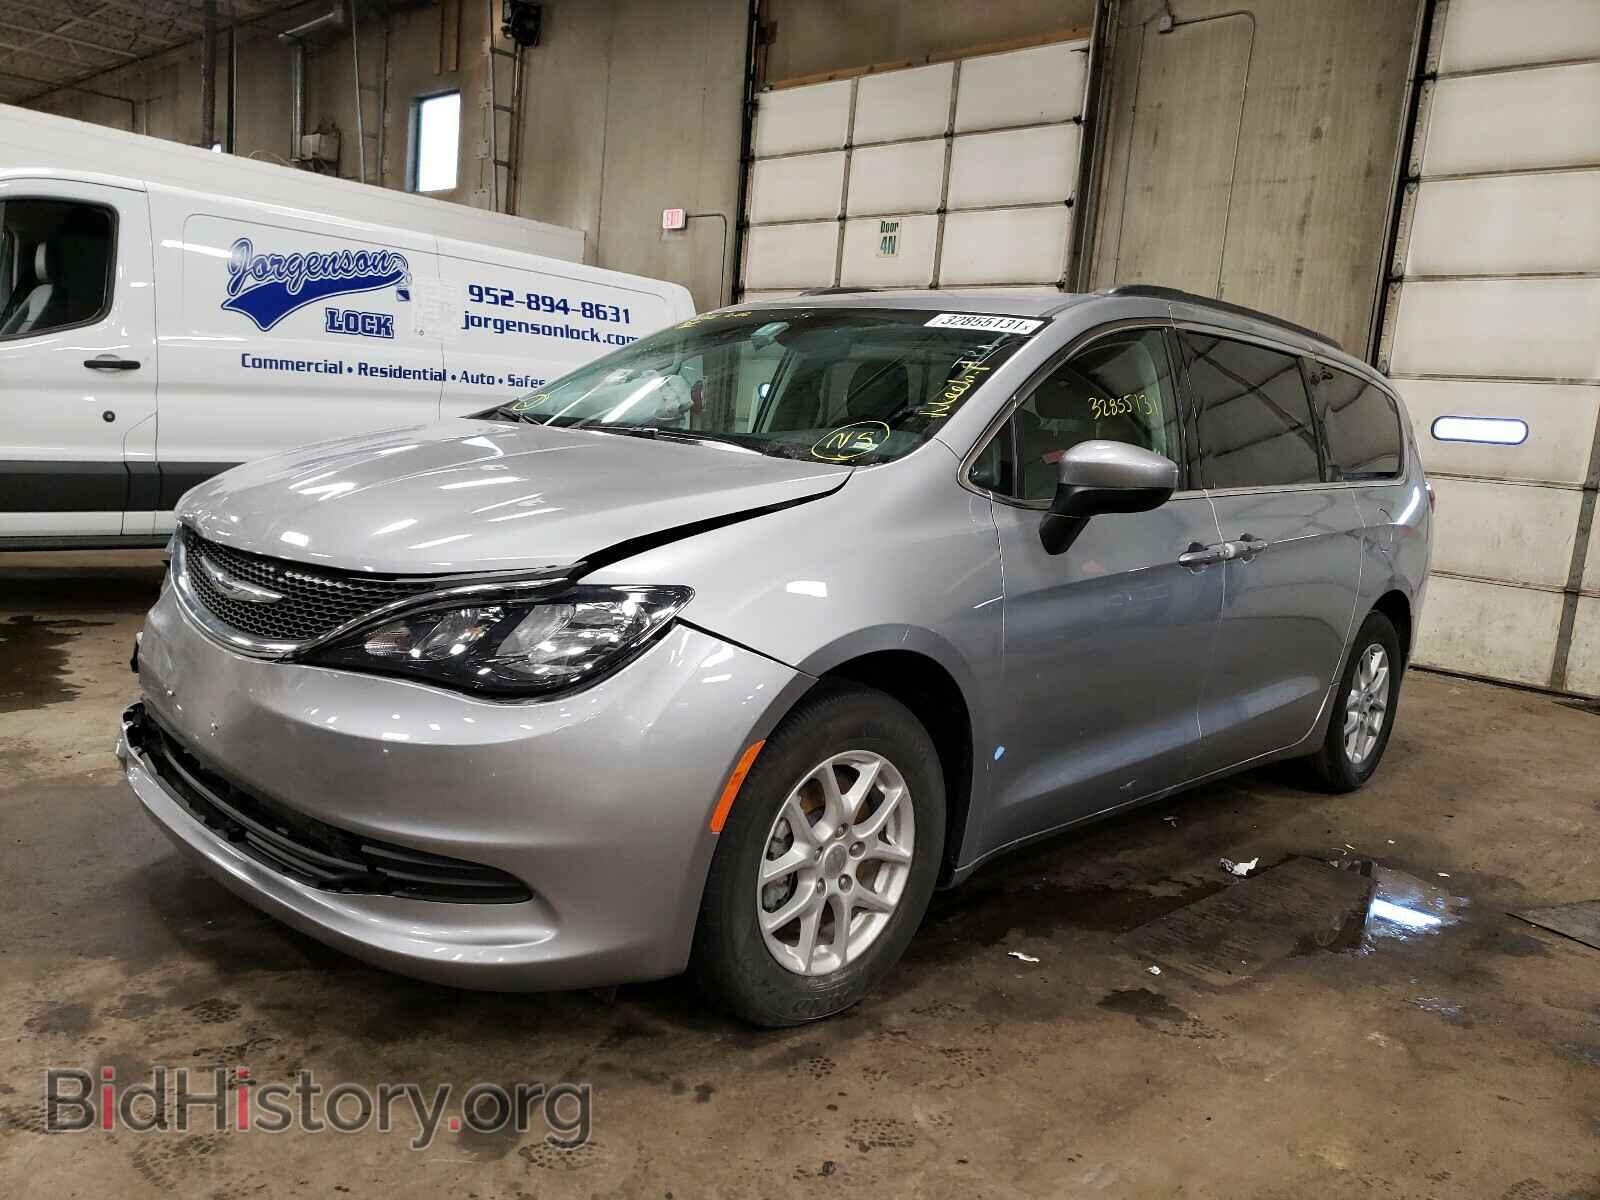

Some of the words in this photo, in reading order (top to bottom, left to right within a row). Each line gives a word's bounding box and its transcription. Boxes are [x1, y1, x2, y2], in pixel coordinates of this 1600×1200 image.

[880, 220, 899, 233] Door
[880, 235, 897, 254] 4N
[227, 238, 395, 296] Jorgenson
[468, 284, 630, 324] 952-894-8631
[325, 307, 394, 339] LOCK
[941, 314, 1026, 330] 32855131
[241, 353, 343, 375] Commercial
[358, 362, 447, 382] Residential
[459, 370, 495, 385] Auto
